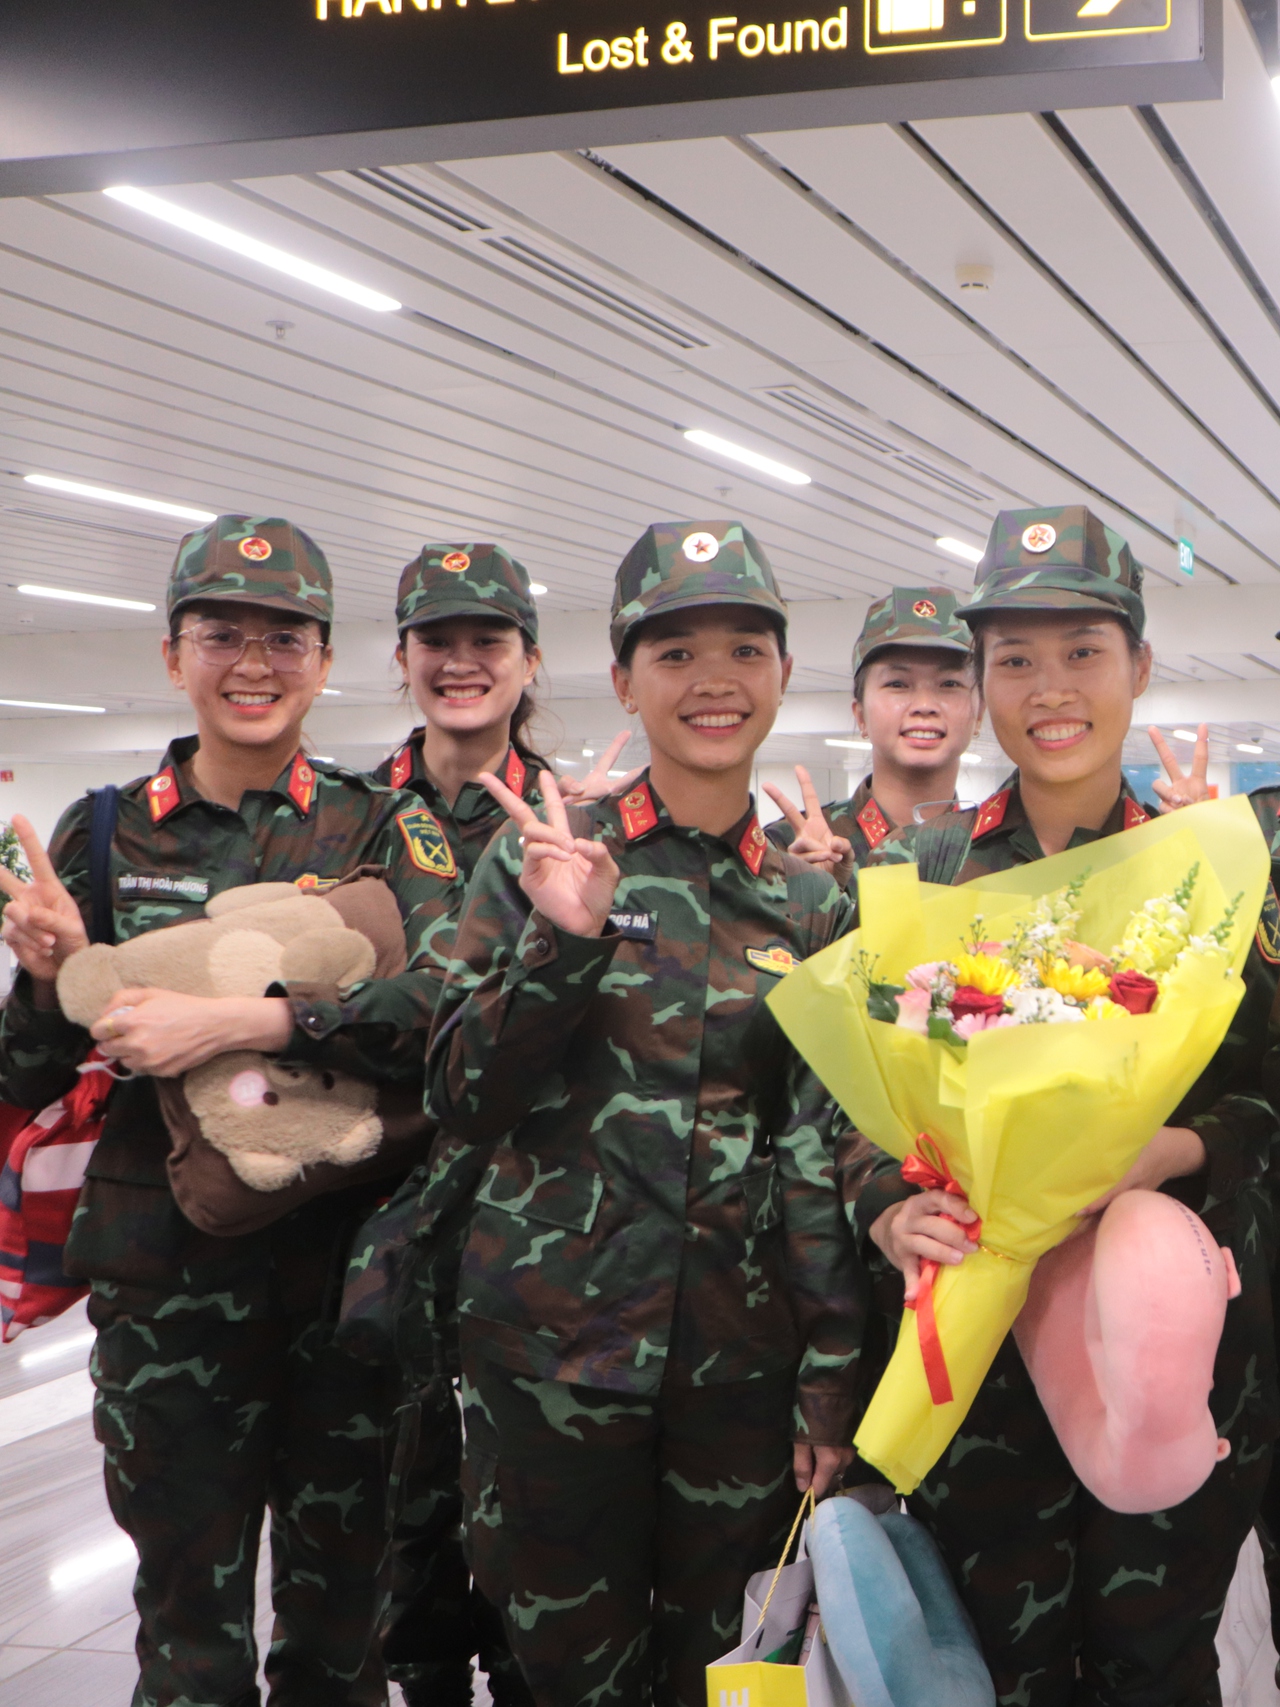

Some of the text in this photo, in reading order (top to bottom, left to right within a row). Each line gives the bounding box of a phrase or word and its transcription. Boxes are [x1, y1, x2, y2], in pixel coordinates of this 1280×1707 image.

[557, 5, 849, 75] Lost & Found
